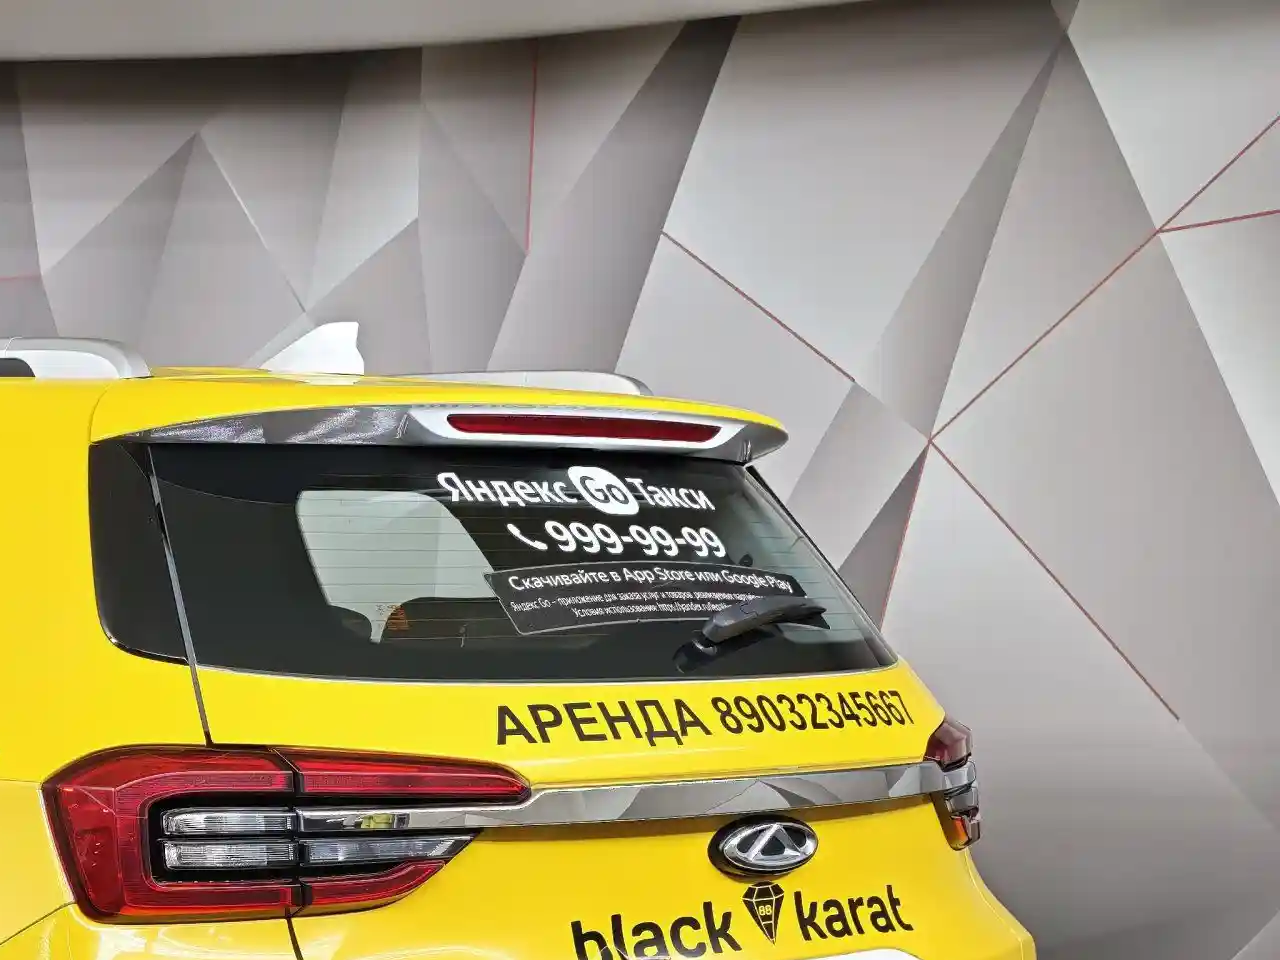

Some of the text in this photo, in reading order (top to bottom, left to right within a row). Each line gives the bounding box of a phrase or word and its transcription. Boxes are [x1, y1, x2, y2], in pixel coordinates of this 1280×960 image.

[437, 472, 716, 511] Яндекс Go Такси
[543, 520, 726, 557] 999-99-99
[508, 567, 794, 593] Скачивайте в App Store или Google Play
[496, 690, 915, 747] АРЕНДА 89032345667
[794, 884, 915, 941] karat
